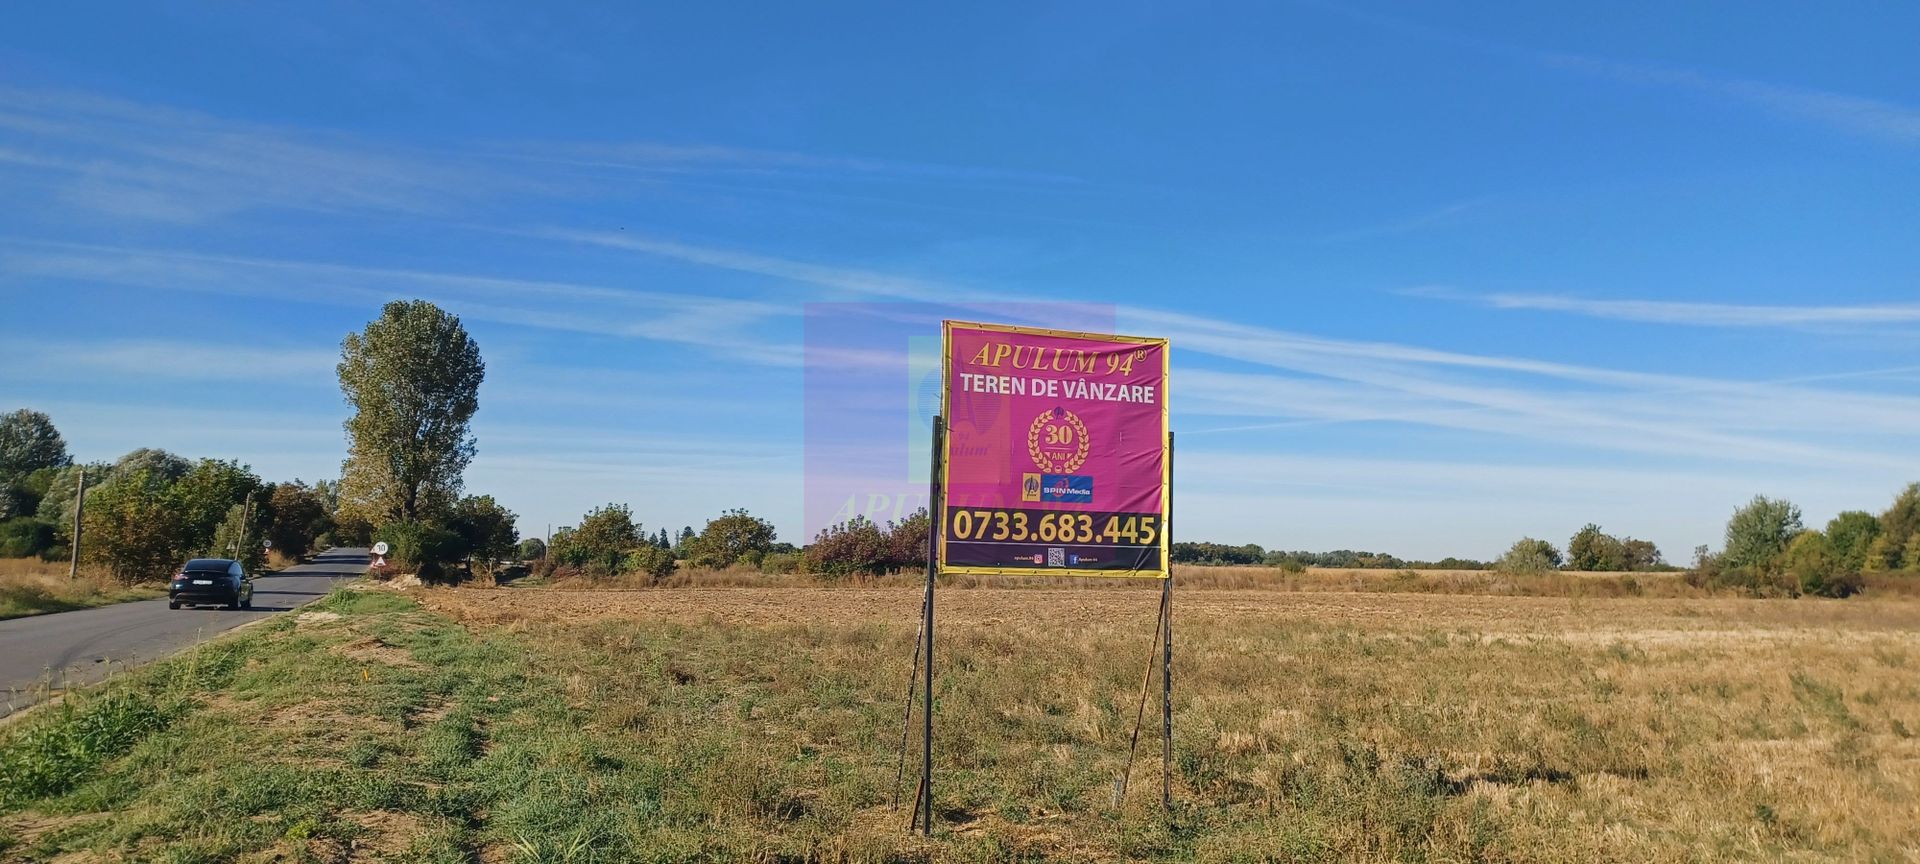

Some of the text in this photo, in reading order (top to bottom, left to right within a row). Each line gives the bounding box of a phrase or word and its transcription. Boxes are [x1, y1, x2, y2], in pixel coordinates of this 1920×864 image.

[970, 342, 1098, 374] APULUM
[960, 373, 1154, 404] TEREN DE VÂNZARE
[1045, 424, 1073, 445] 30
[1051, 452, 1066, 461] ANI
[953, 510, 1156, 544] 0733.683.445
